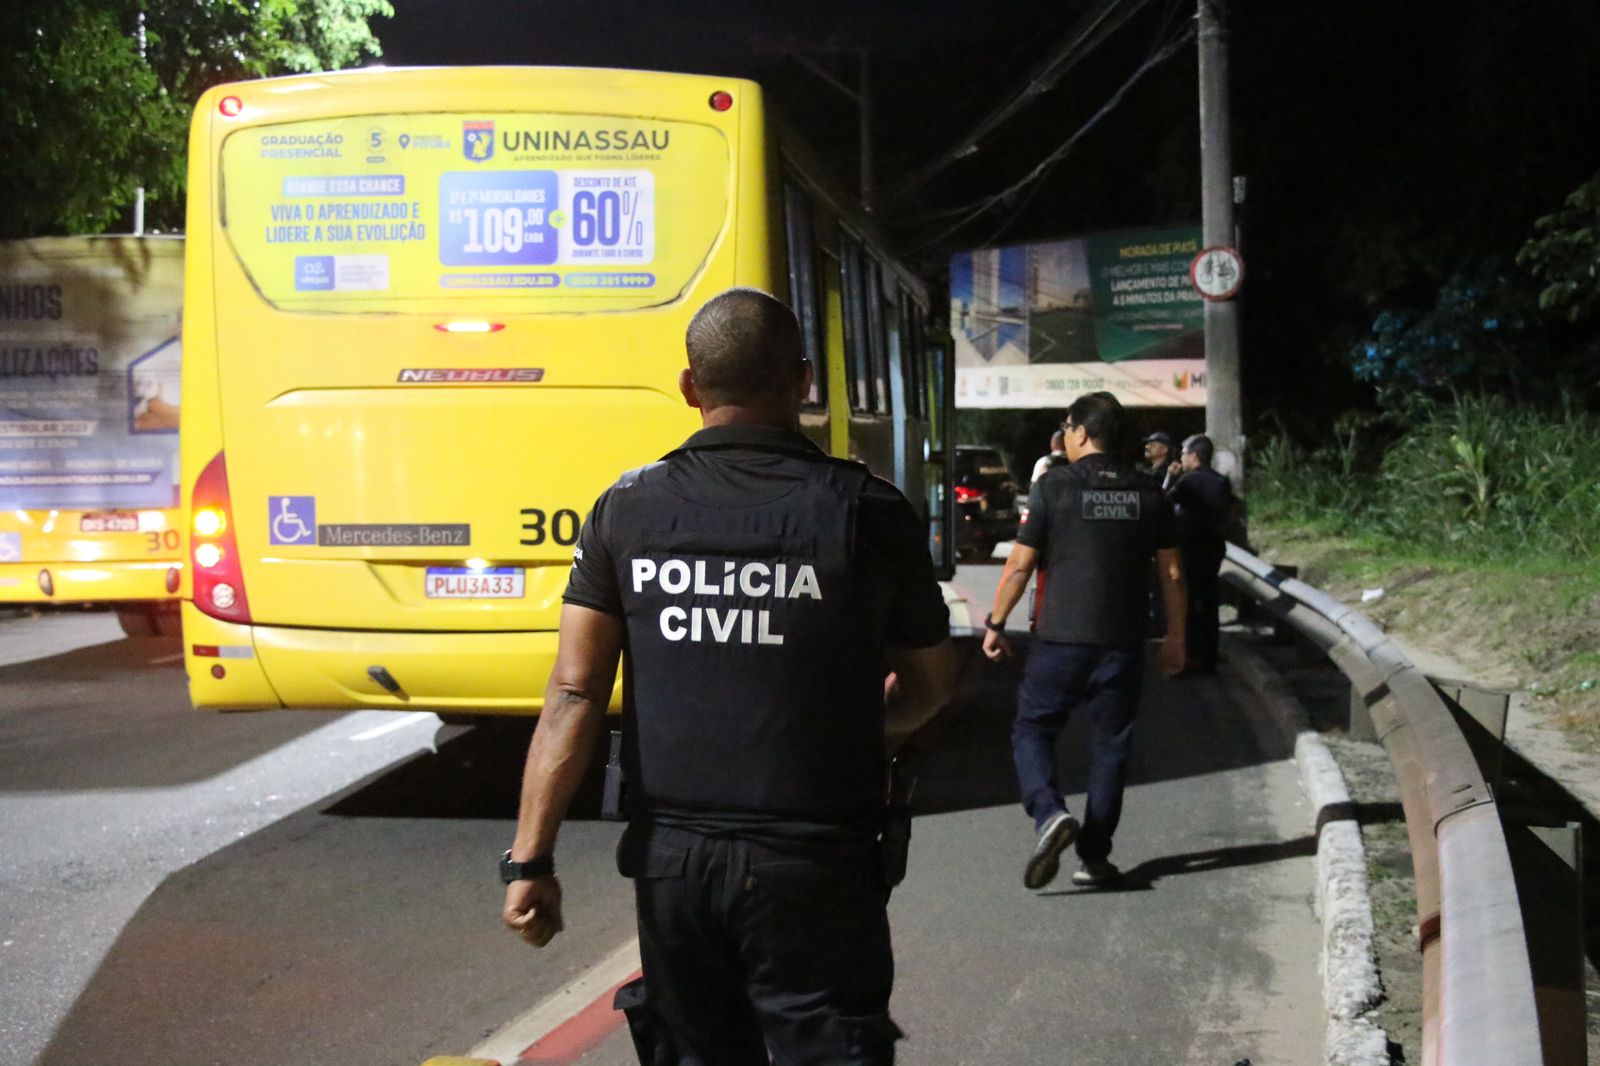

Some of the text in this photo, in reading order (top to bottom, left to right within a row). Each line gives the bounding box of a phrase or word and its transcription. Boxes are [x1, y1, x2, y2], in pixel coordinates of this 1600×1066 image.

[260, 133, 343, 147] GRADUAÇÃO
[370, 132, 382, 148] 5
[503, 130, 670, 151] UNINASSAU
[260, 147, 343, 159] PRESENCIAL
[575, 154, 592, 162] QUE
[329, 179, 357, 194] ESSA
[359, 178, 400, 193] CHANCE
[573, 176, 637, 189] DESCONTO DE ATÉ
[479, 189, 545, 203] MENSALIDADES
[271, 202, 420, 221] VIVA O APRENDIZADO E
[266, 221, 426, 243] LIDERE A SUA EVOLUÇÃO
[524, 232, 544, 243] CADA
[572, 249, 599, 258] DURANTE
[622, 276, 650, 287] 9999
[1110, 276, 1166, 292] LANÇAMENTO
[401, 369, 539, 381] NEOBUS
[1094, 505, 1130, 517] CIVIL
[326, 525, 464, 545] Mercedes-Benz
[434, 576, 515, 595] PLU3A33
[631, 558, 822, 600] POLÍCIA
[659, 605, 784, 645] CIVIL
